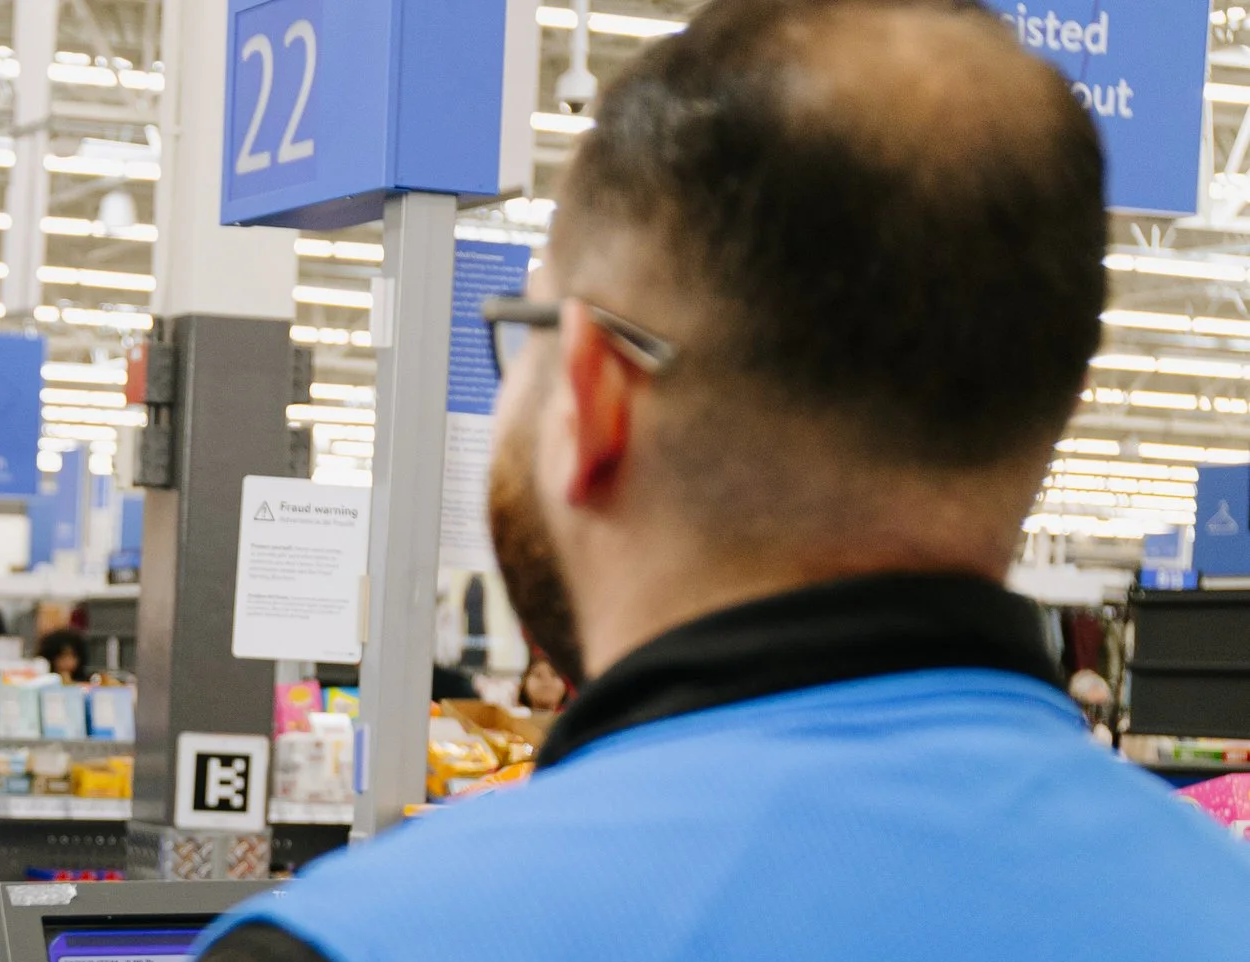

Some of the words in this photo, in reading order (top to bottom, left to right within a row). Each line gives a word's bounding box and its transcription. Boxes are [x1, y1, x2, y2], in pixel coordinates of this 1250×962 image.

[1002, 2, 1109, 55] isted
[235, 18, 317, 175] 22
[279, 500, 312, 513] Fraud
[314, 504, 359, 518] warning
